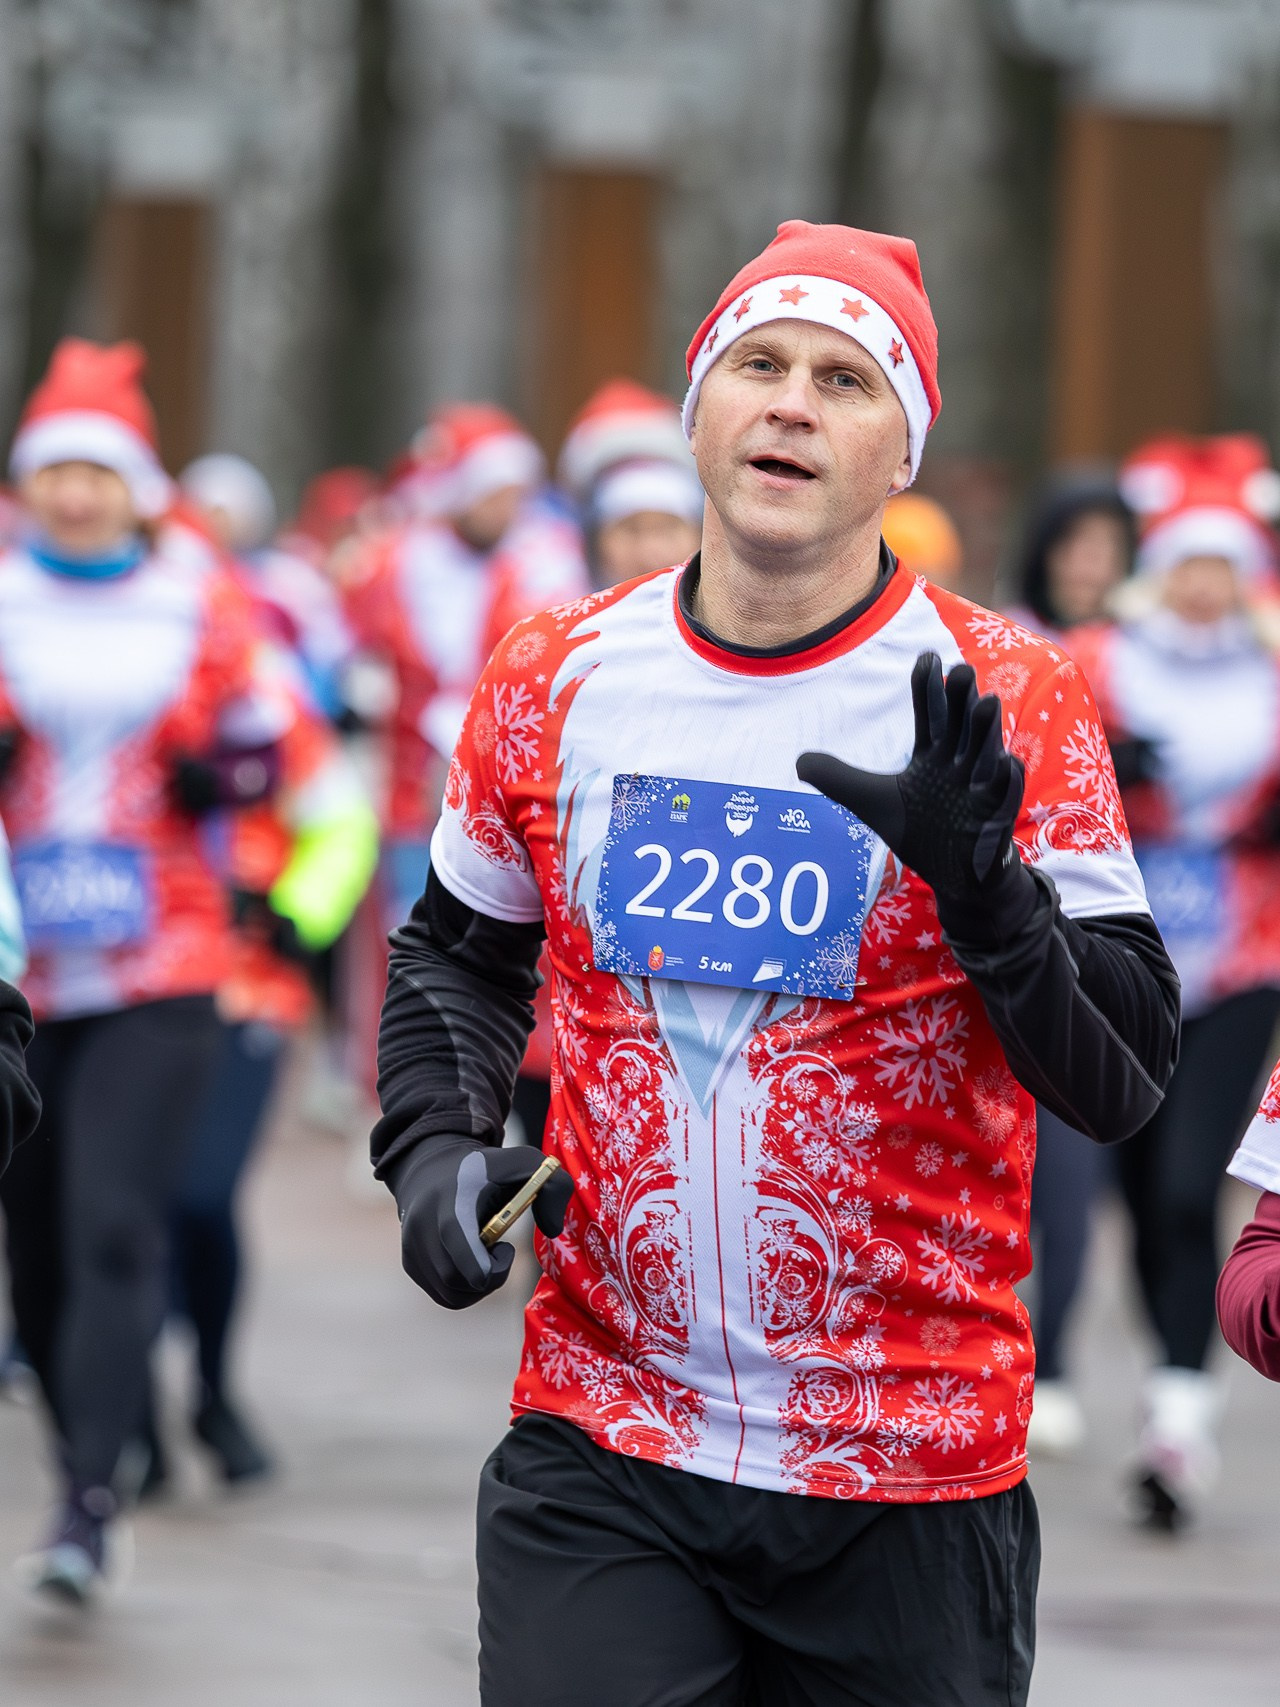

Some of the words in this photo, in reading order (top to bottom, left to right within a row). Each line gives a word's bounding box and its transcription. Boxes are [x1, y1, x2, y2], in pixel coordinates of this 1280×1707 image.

[625, 843, 830, 937] 2280
[698, 956, 710, 970] 5
[710, 960, 733, 973] км
